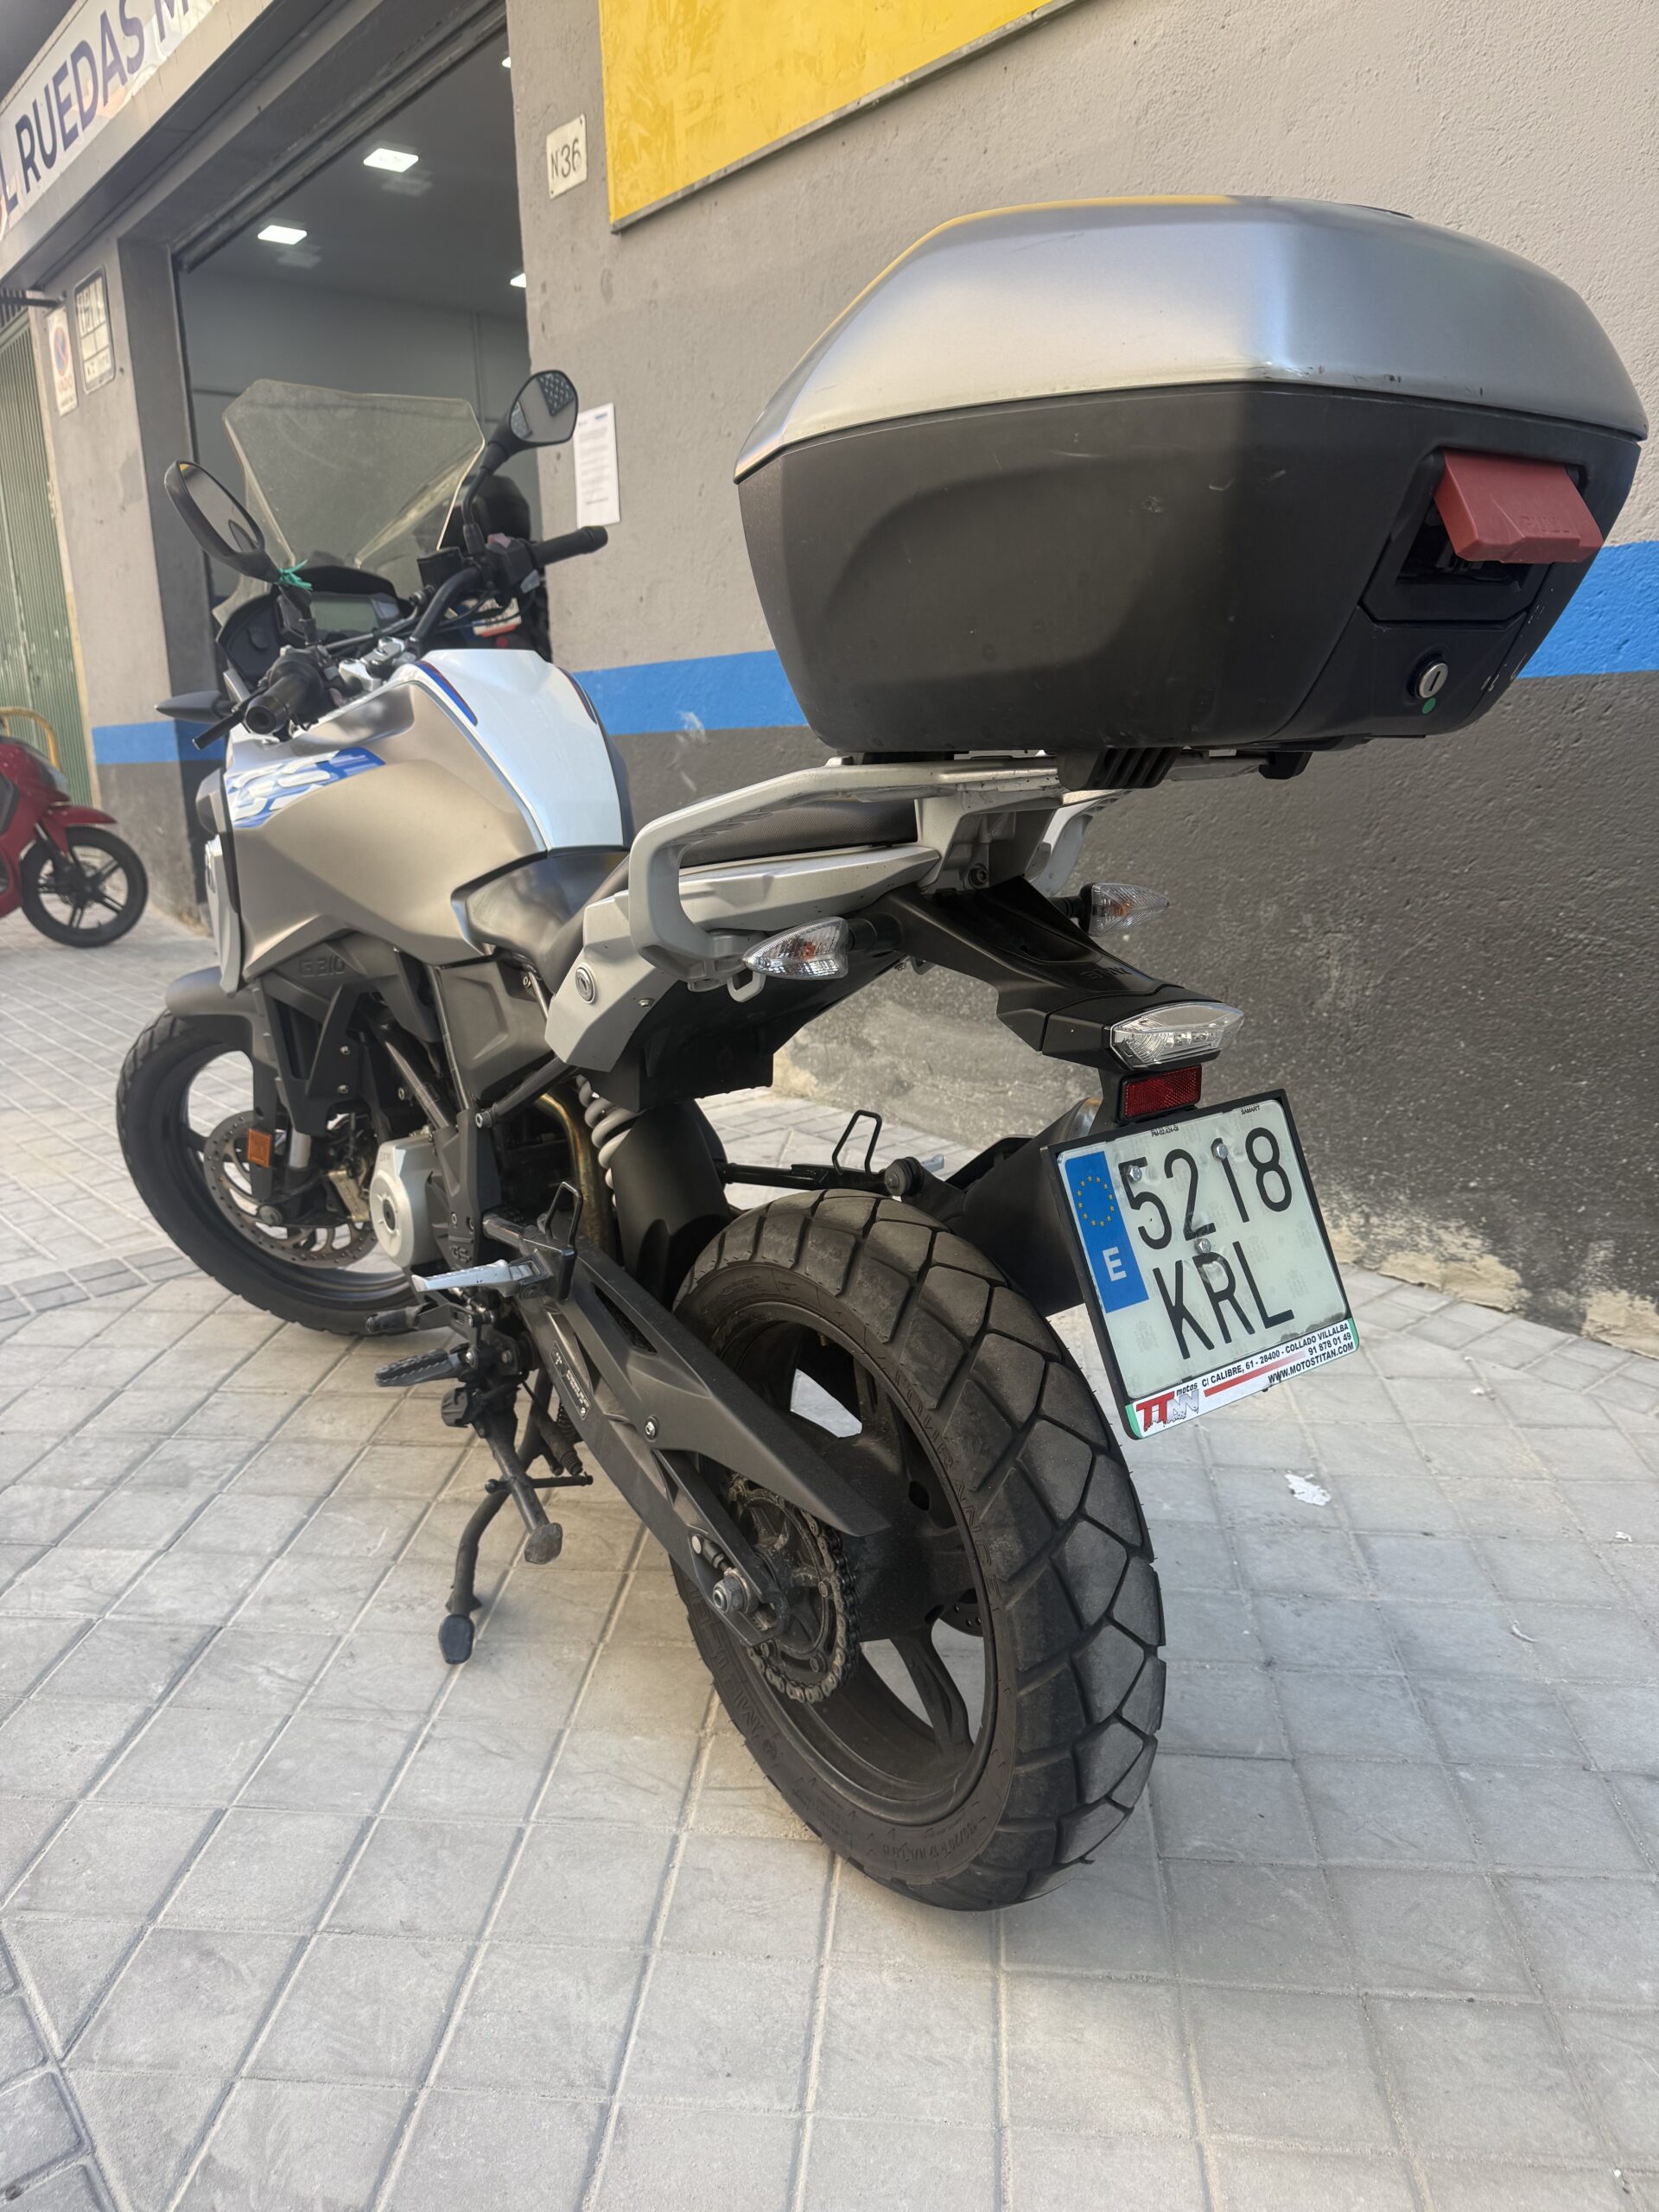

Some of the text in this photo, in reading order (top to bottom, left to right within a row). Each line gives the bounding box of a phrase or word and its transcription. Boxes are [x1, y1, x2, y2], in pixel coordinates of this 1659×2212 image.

[16, 0, 145, 194] RUEDAS
[1118, 1127, 1293, 1250] 5218
[1103, 1247, 1126, 1282] E
[1153, 1241, 1294, 1360] KRL
[1211, 1364, 1244, 1382] CALIBRE,
[1245, 1360, 1254, 1370] 61
[1259, 1351, 1281, 1364] 28400
[1285, 1337, 1317, 1354] COLLADO
[1318, 1322, 1350, 1341] VILLALBA
[1268, 1341, 1354, 1384] WWW.MOTOSTITAN.COM
[1308, 1332, 1351, 1356] 91 878 01 49
[1176, 1382, 1198, 1396] motos
